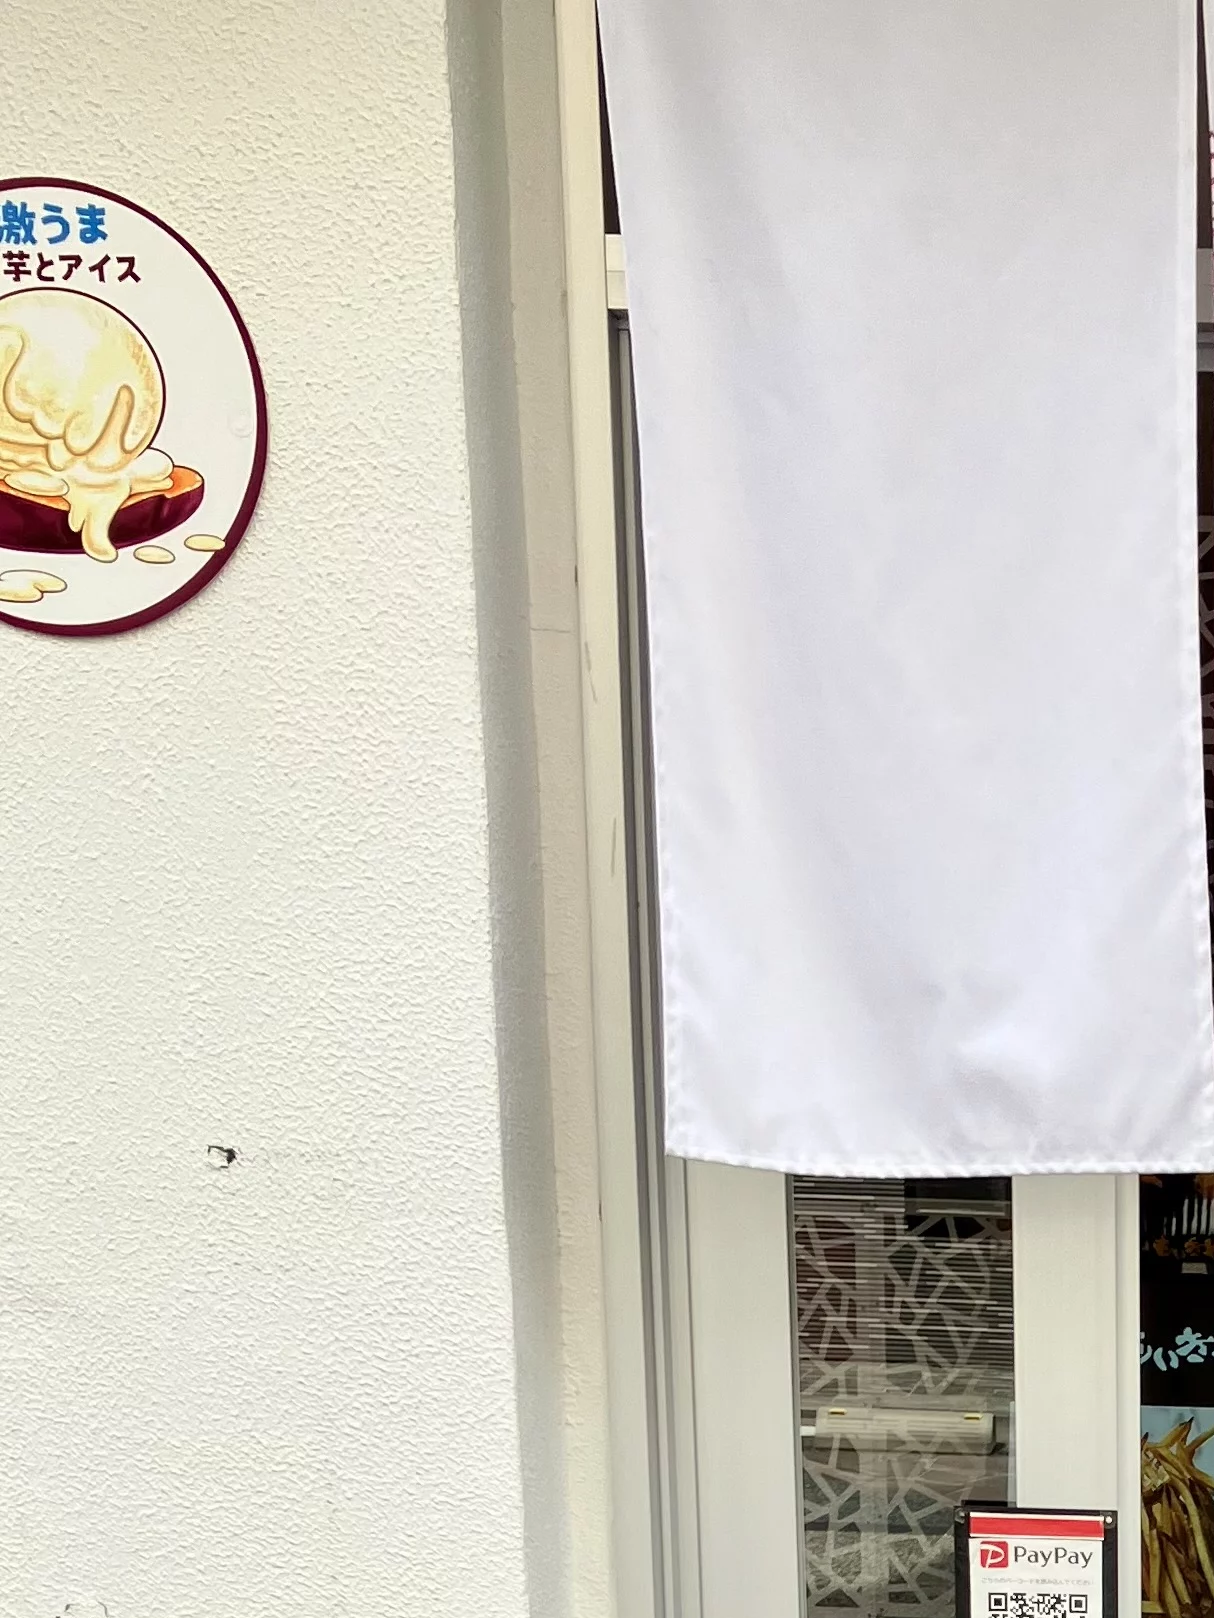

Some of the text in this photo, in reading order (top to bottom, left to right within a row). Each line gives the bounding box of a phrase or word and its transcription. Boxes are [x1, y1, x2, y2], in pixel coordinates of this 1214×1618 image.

[3, 250, 141, 283] 芋とアイス
[1013, 1545, 1094, 1569] PayPay
